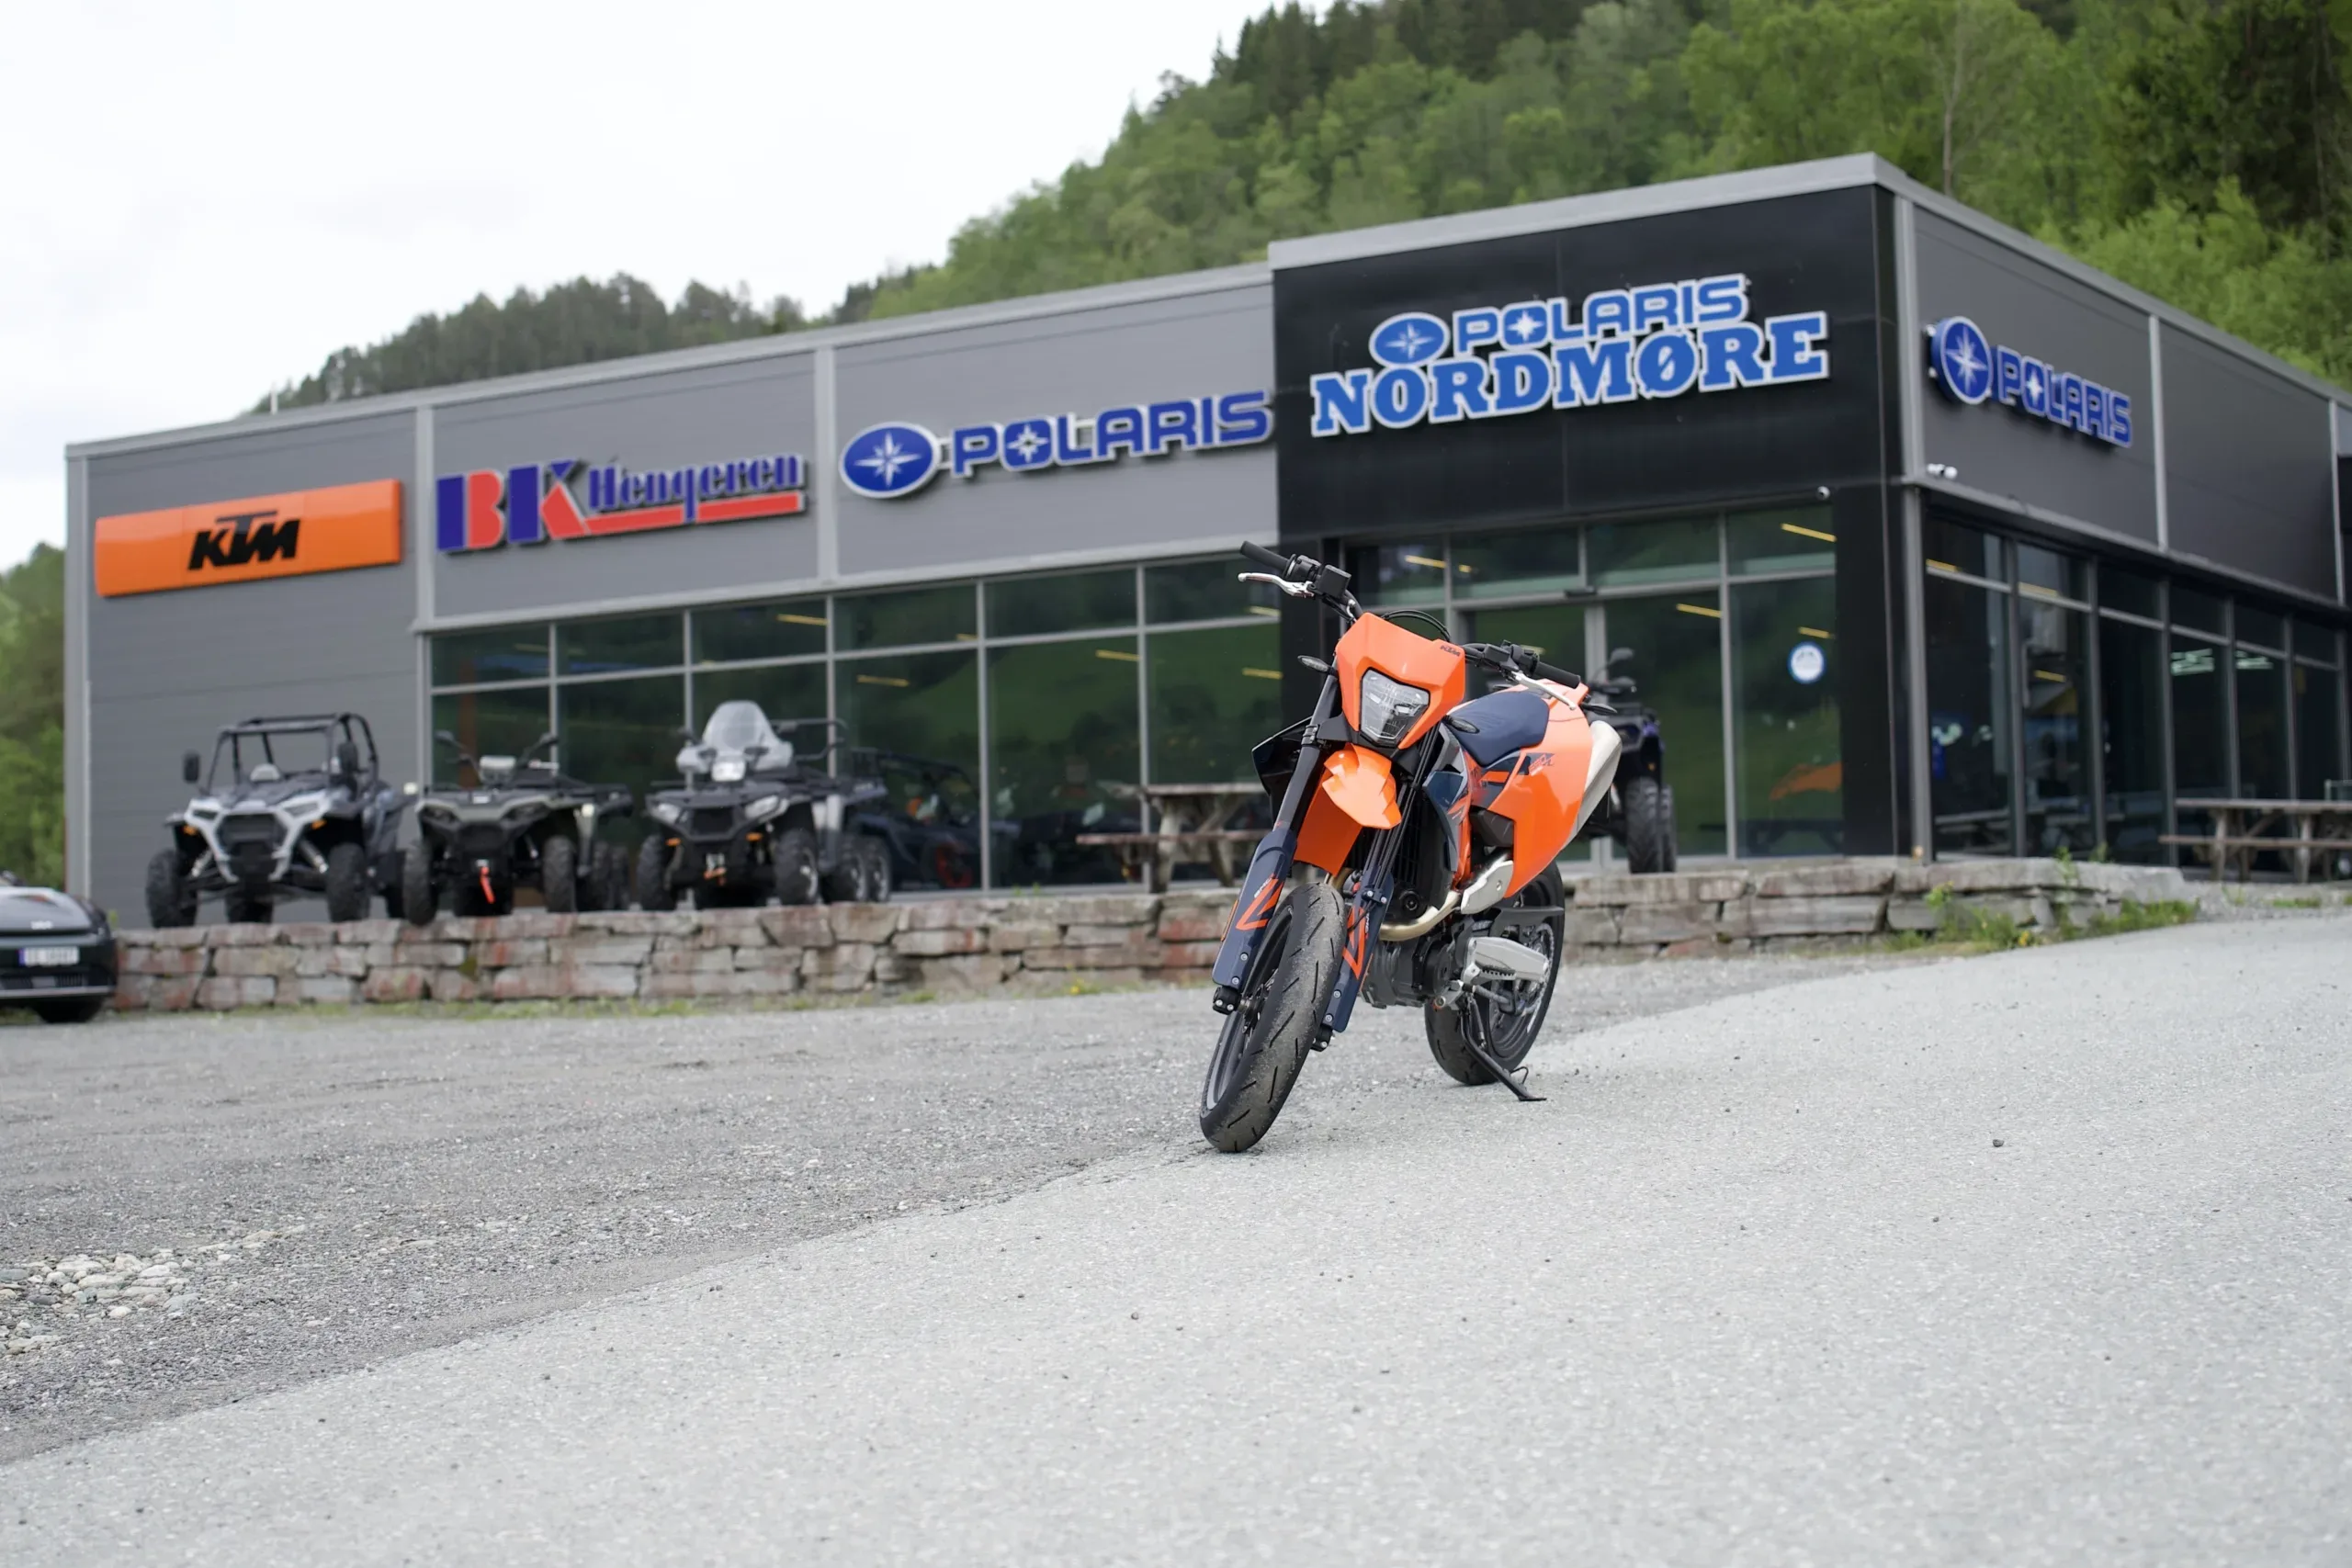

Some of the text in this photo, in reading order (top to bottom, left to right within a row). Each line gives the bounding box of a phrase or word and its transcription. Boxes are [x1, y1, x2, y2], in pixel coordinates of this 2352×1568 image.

[1453, 274, 1747, 357] POLARIS
[1311, 311, 1828, 437] NORDMØRE
[1996, 344, 2133, 448] POLARIS
[952, 389, 1275, 479] POLARIS
[187, 510, 301, 571] KTM
[435, 454, 805, 552] BK Hengeren
